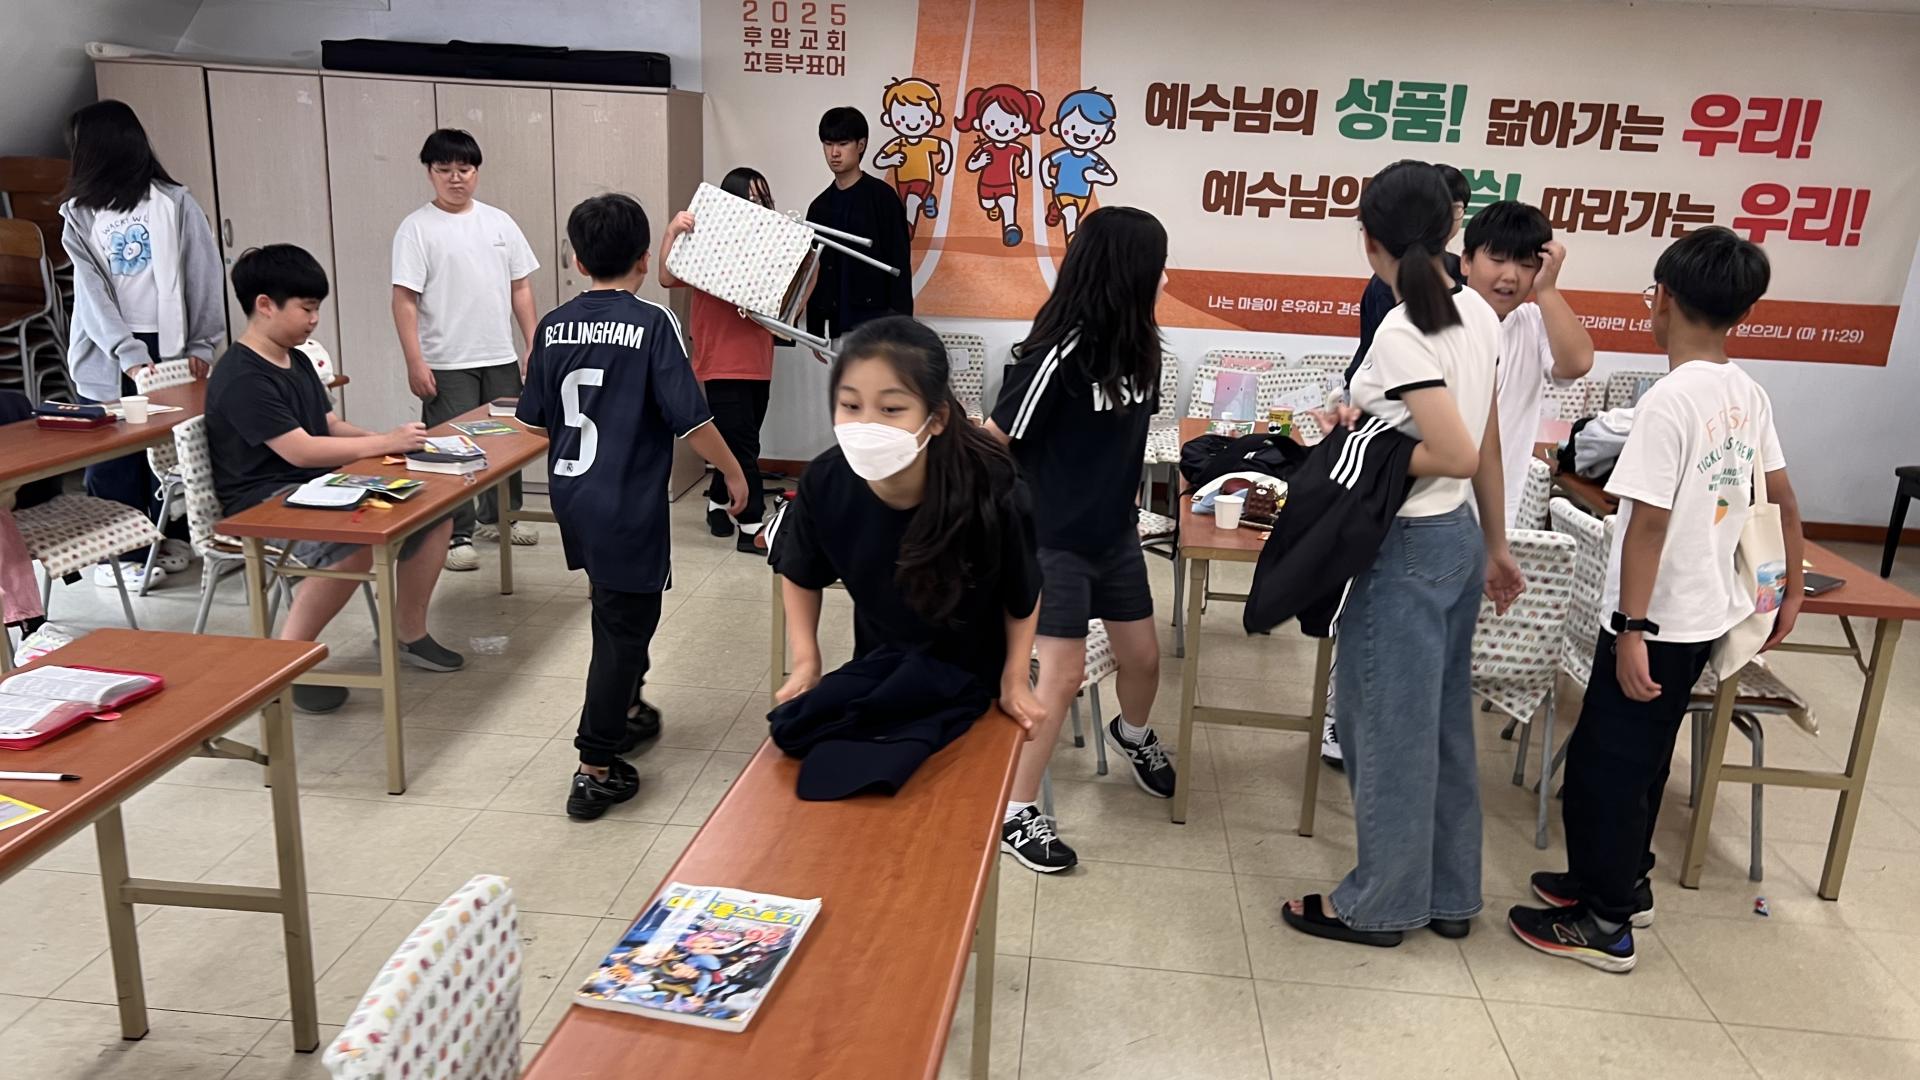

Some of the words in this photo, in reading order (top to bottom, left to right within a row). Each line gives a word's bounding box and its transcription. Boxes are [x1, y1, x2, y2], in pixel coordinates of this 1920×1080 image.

[743, 0, 846, 25] 2025
[743, 26, 846, 51] 후암교회
[743, 51, 845, 76] 초등부표어
[1145, 82, 1319, 136] 예수님의
[1335, 78, 1468, 143] 성품!
[1486, 98, 1665, 153] 닮아가는
[1682, 94, 1823, 159] 우리!
[1202, 169, 1374, 220] 예수님의
[1541, 187, 1715, 238] 따라가는
[1732, 182, 1871, 246] 우리!
[545, 321, 645, 350] BELLINGHAM
[1208, 295, 1234, 310] 나는
[1237, 296, 1277, 312] 마음이
[1281, 299, 1333, 314] 온유하고
[1736, 323, 1792, 339] 얻으리니
[1796, 326, 1816, 341] (마
[1821, 328, 1865, 344] 11:29)
[554, 368, 604, 477] 5
